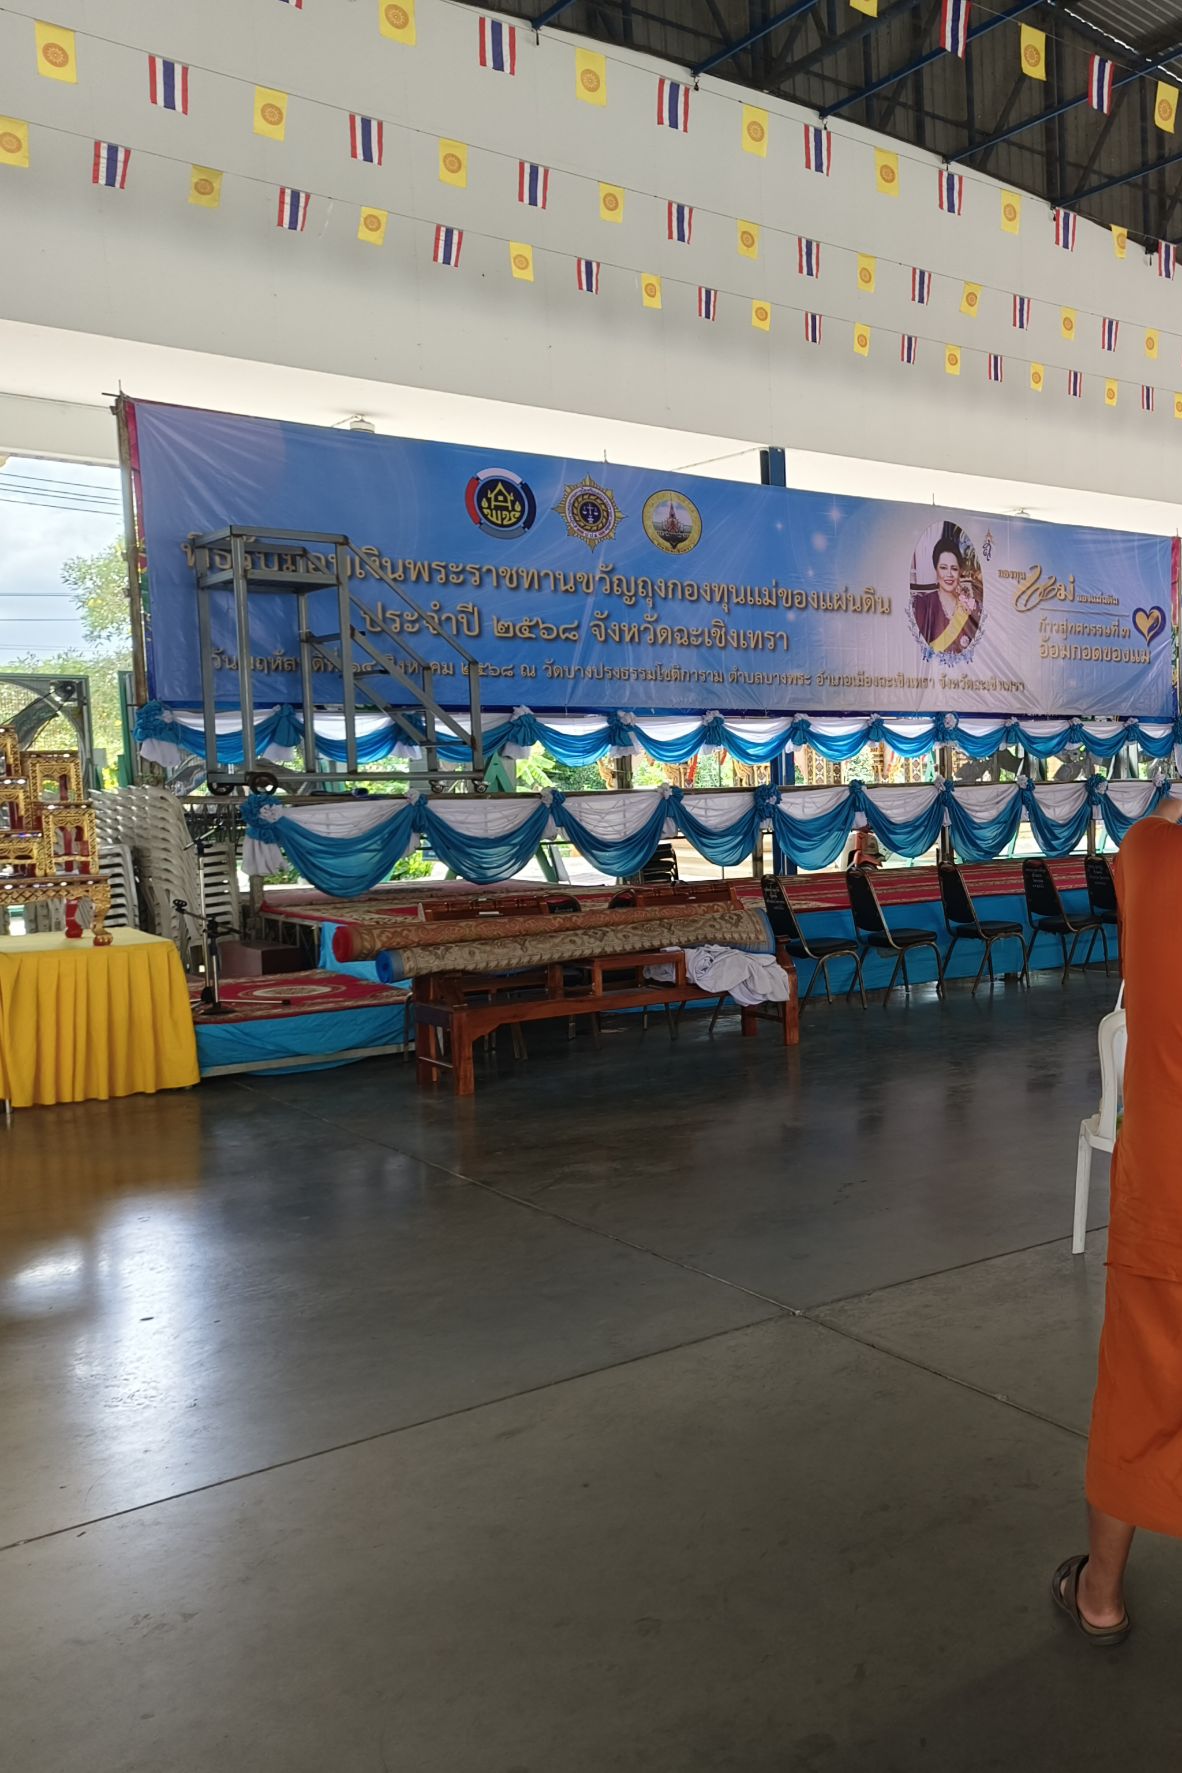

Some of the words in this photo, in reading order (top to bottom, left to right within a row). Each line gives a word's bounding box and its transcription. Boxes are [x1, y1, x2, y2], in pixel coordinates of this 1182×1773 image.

[180, 531, 892, 614] พิธับมอบเงินพระราชทานขวัญถุงกองทุนแม่ของแผ่นดิน
[361, 600, 481, 637] ประจำปี
[491, 615, 579, 641] ๒๕๖๘
[590, 610, 790, 651] จังหวัดฉะเชิงเทรา
[211, 648, 340, 674] วันฤหัสดีที่
[520, 663, 536, 678] ณ
